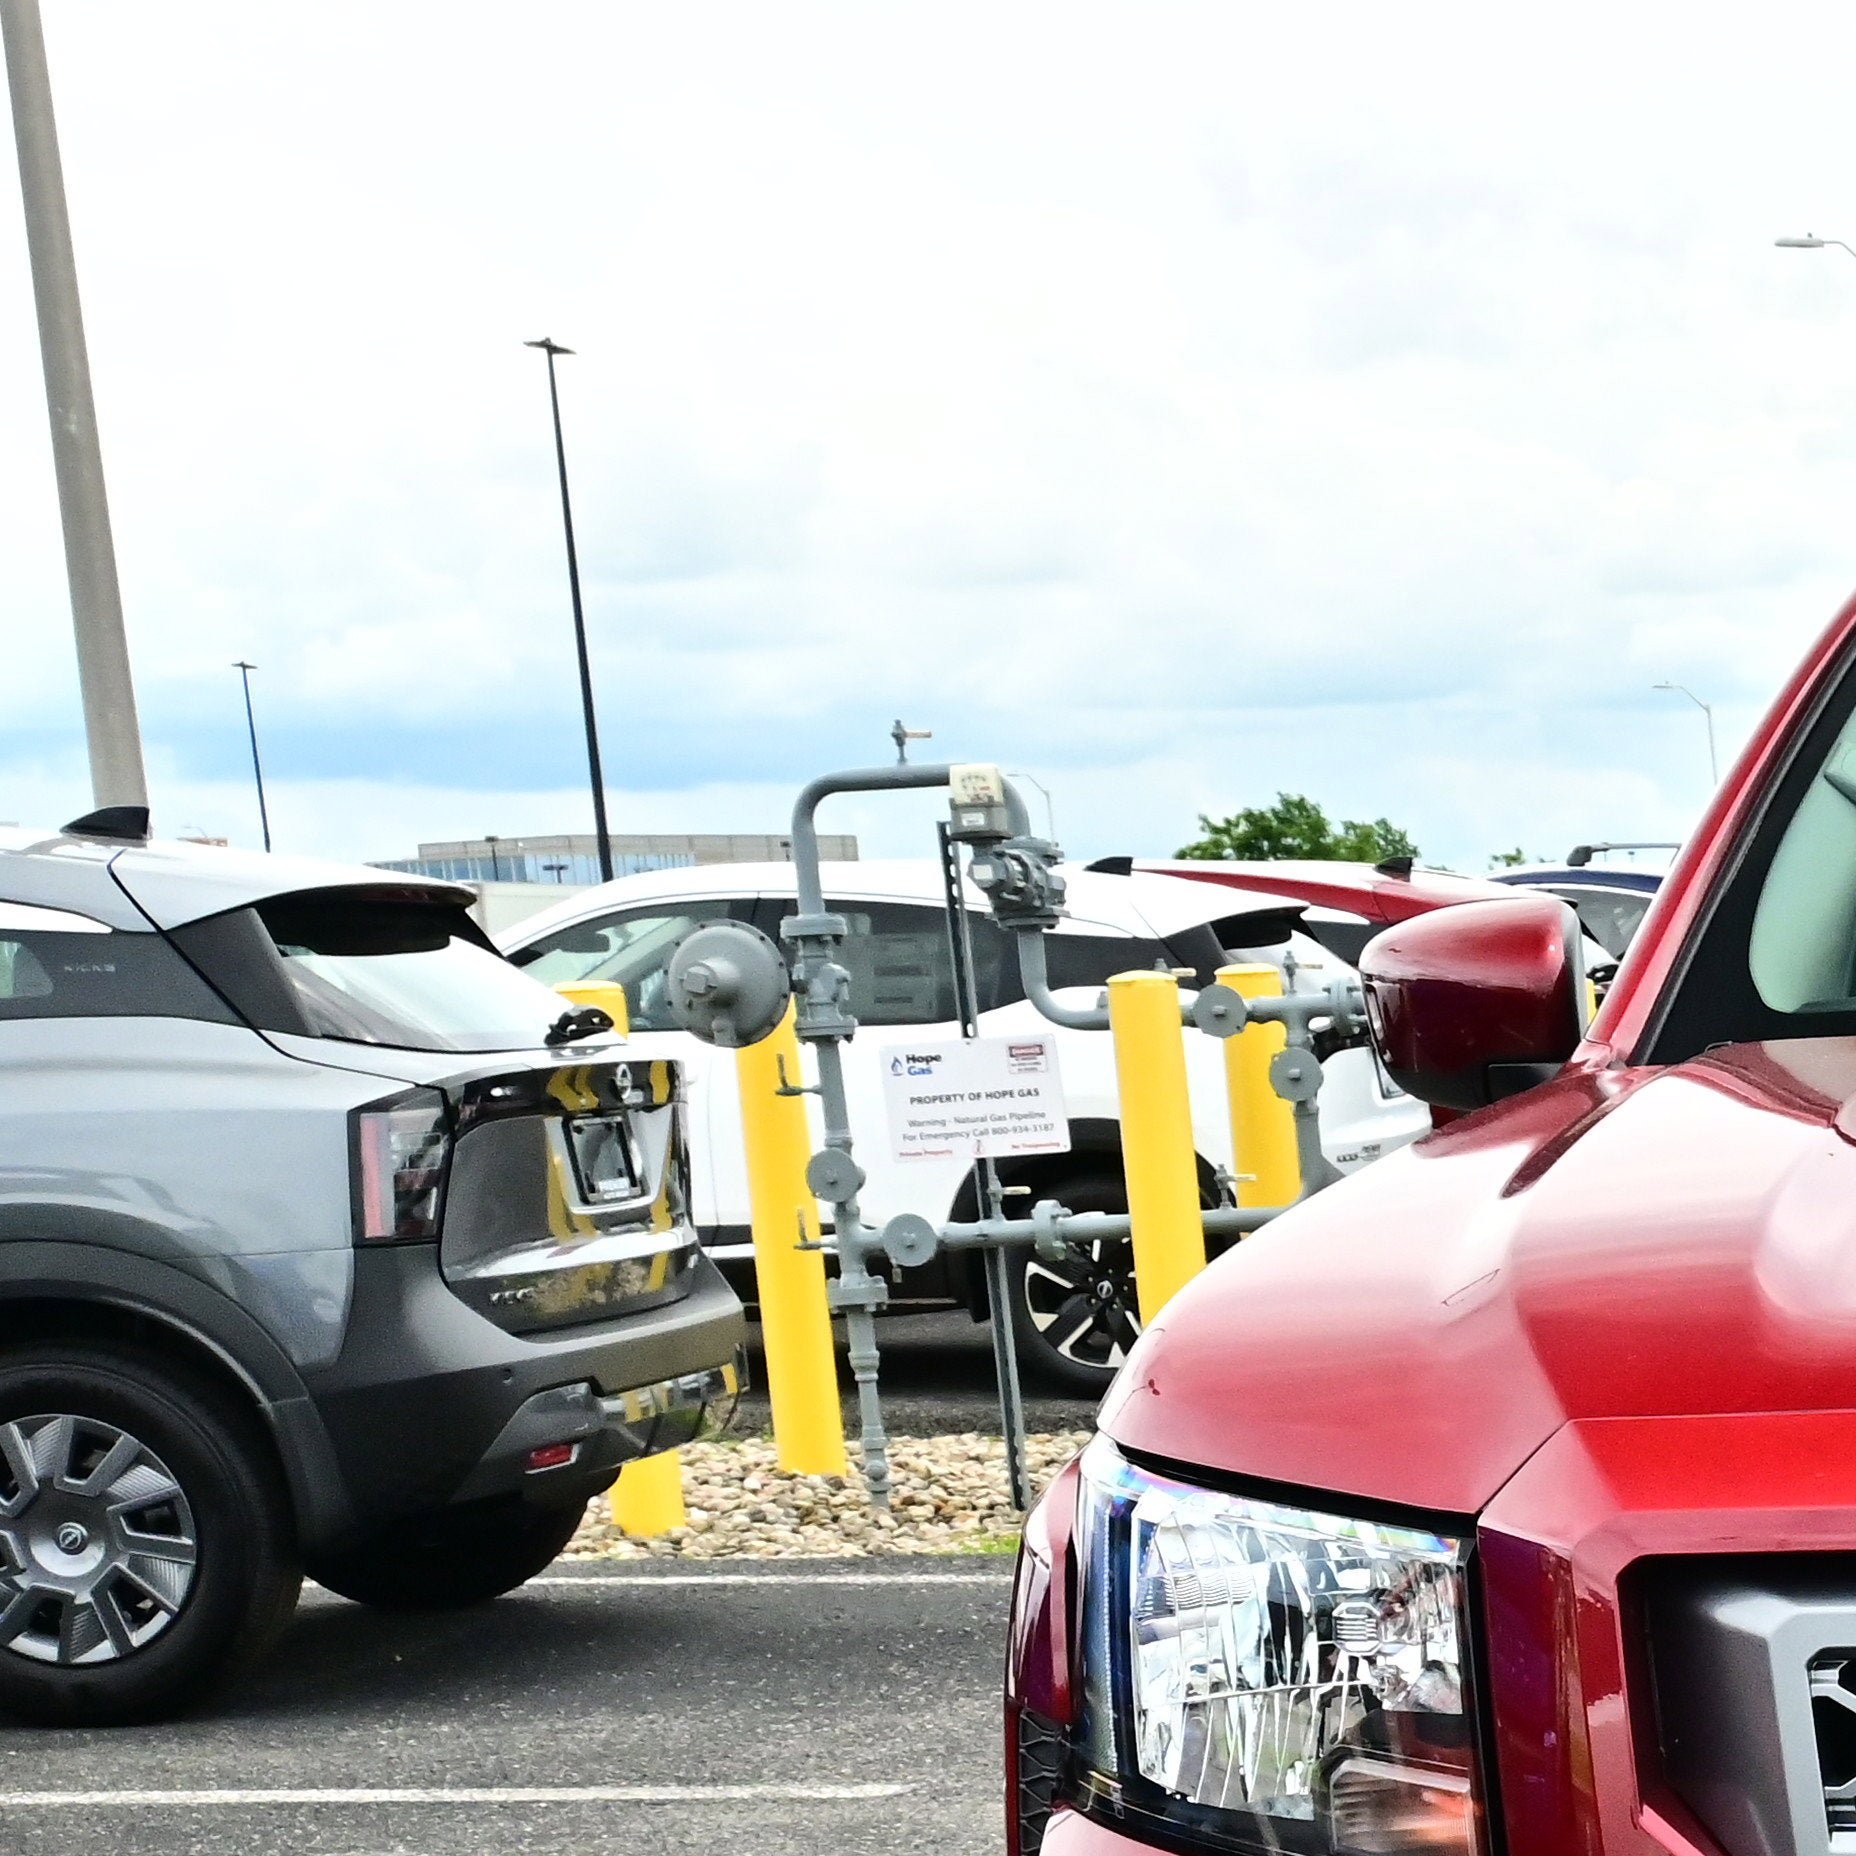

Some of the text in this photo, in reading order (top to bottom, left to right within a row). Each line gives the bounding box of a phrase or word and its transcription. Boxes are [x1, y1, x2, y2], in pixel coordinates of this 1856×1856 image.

[905, 1053, 942, 1065] Hope
[907, 1065, 933, 1076] Gas
[909, 1087, 1040, 1106] PROPERTY OF HOPE GAS
[907, 1118, 947, 1128] Warning
[953, 1114, 988, 1124] Natural
[989, 1113, 1007, 1122] Gas
[1009, 1110, 1046, 1122] Pipeline
[902, 1132, 917, 1142] For
[919, 1130, 970, 1142] Emergency
[973, 1127, 990, 1137] Call
